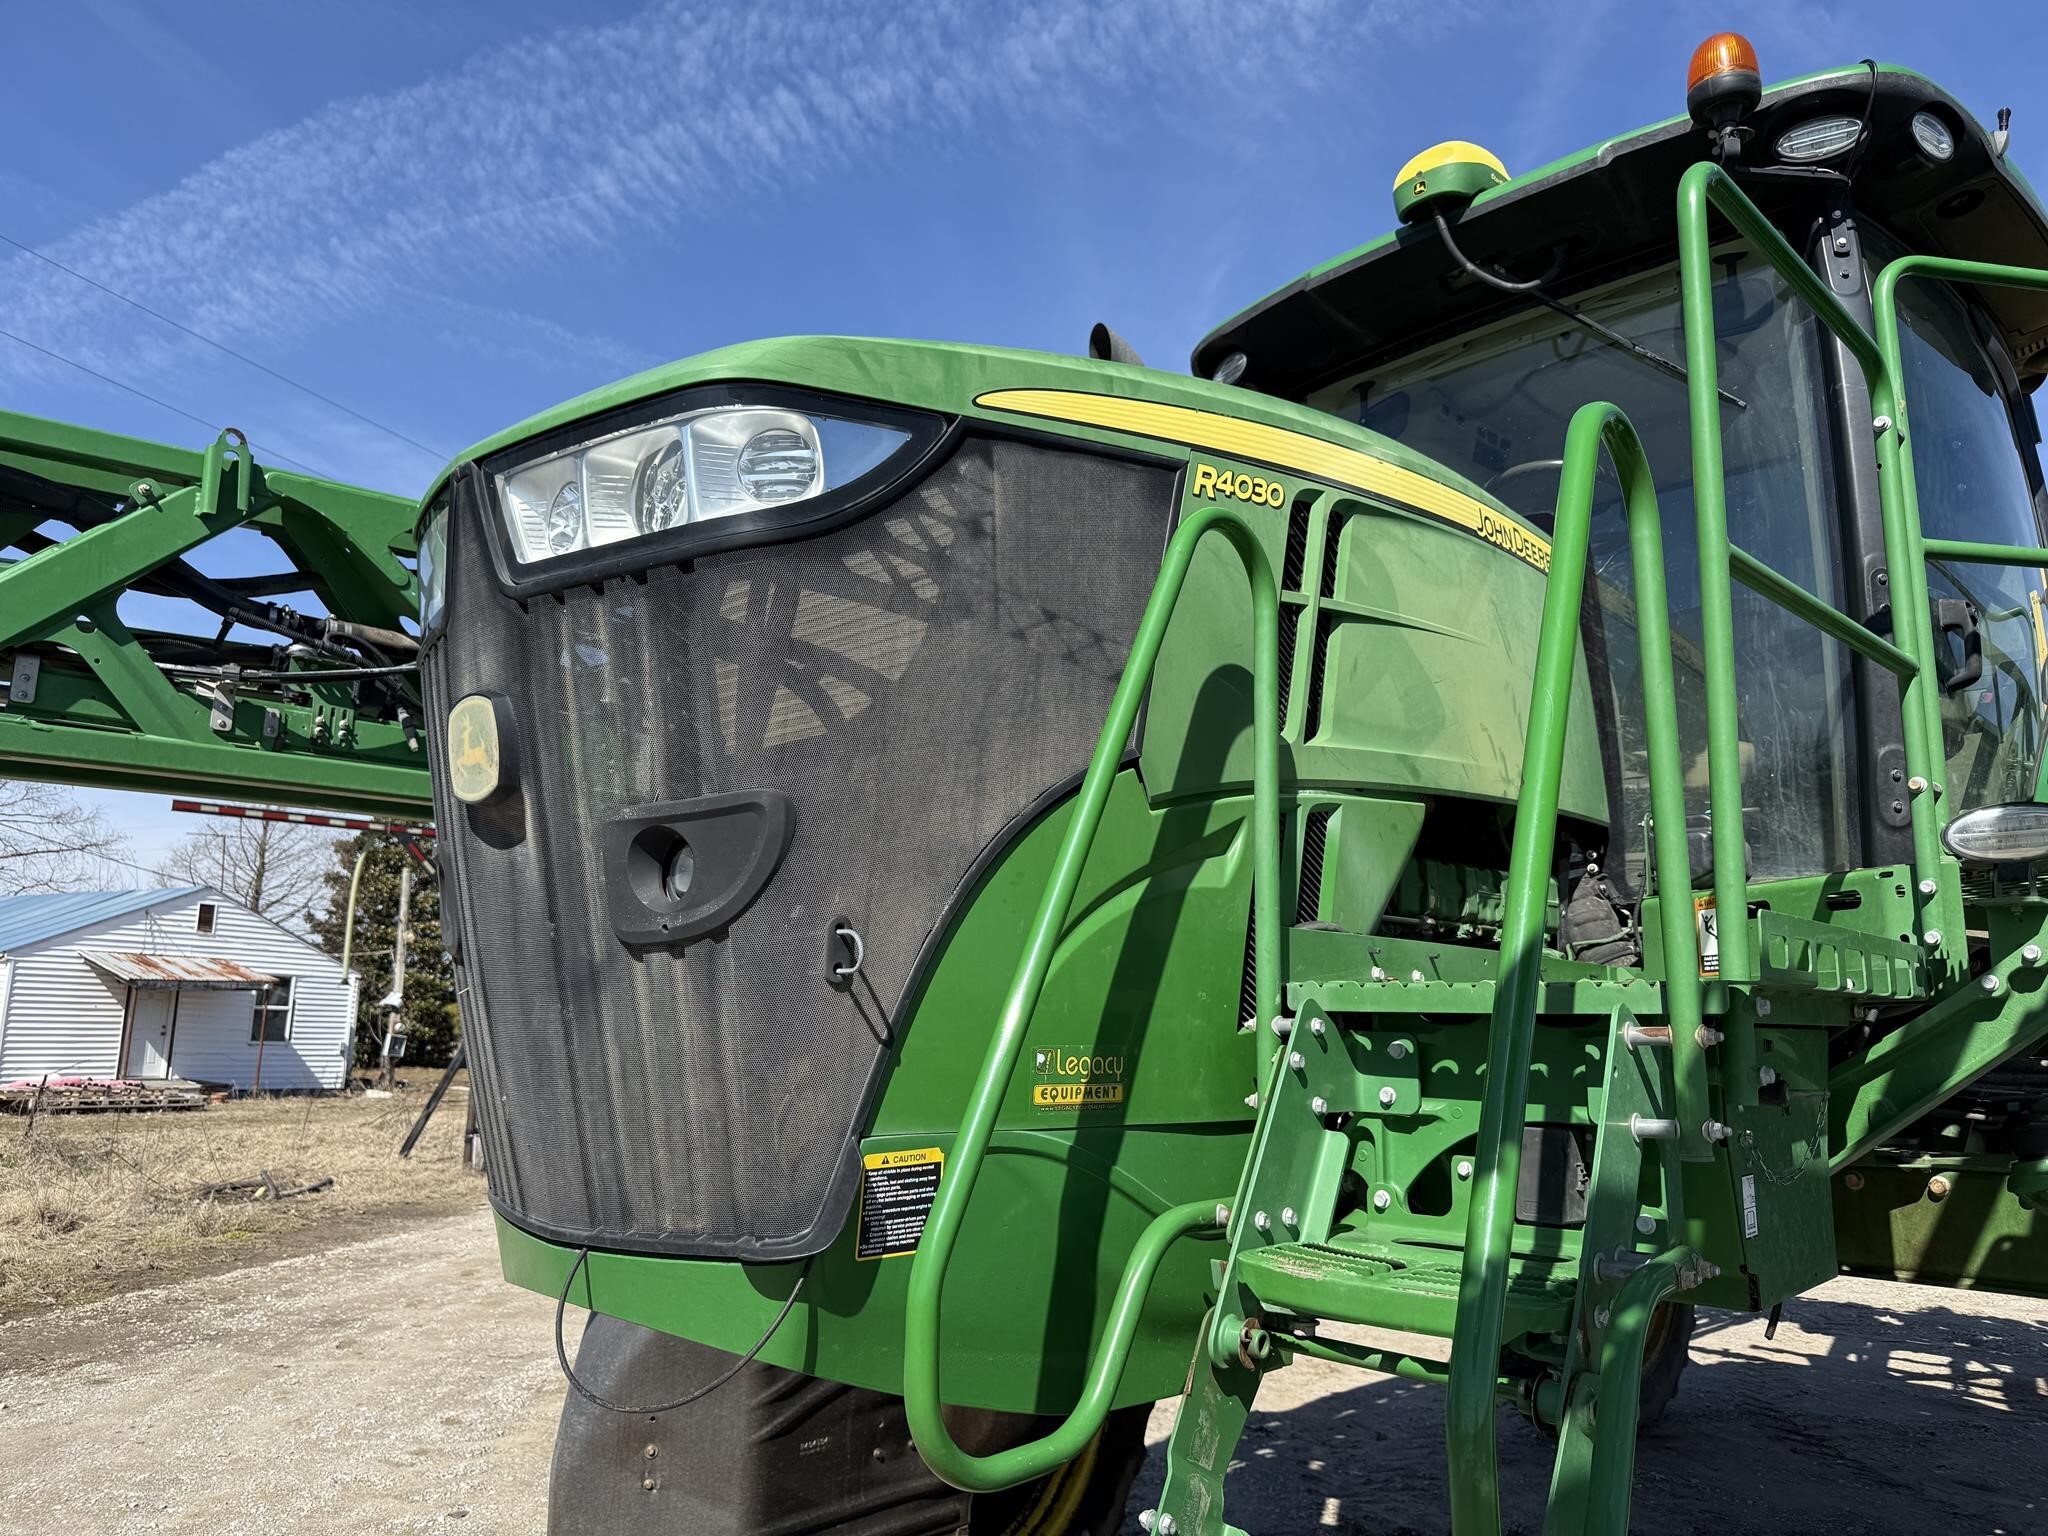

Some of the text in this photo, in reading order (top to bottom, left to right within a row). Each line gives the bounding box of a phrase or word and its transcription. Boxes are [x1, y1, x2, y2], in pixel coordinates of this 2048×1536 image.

[1192, 463, 1285, 509] R4030
[1476, 507, 1513, 550] JOHN
[1056, 1048, 1124, 1082] Legacy
[1040, 1086, 1118, 1102] EQUIPMENT
[893, 1153, 927, 1164] CAUTION
